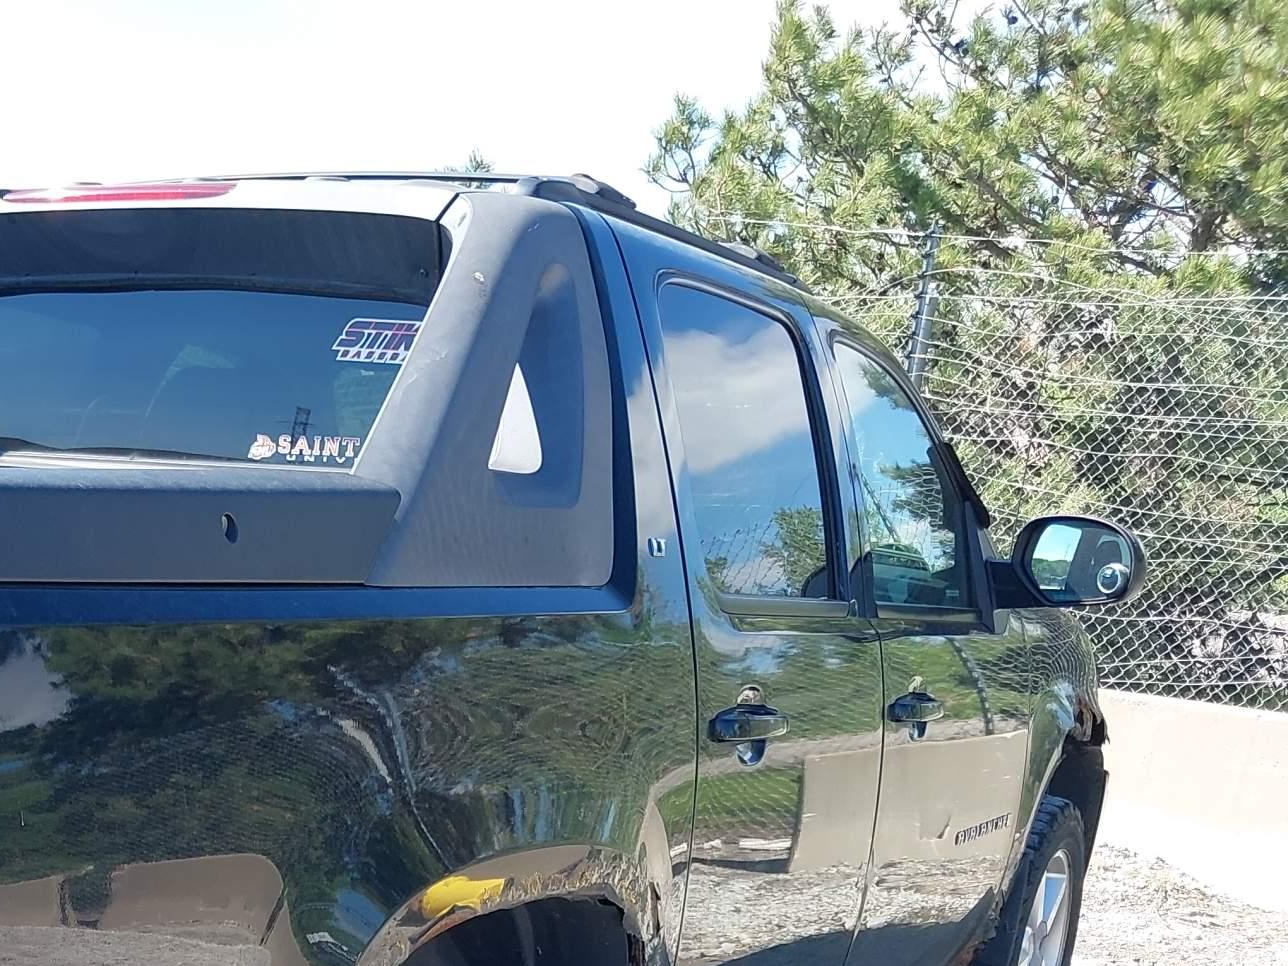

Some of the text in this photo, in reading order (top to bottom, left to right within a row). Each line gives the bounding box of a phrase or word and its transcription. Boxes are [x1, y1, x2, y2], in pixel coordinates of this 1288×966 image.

[338, 349, 408, 361] BASEB
[277, 434, 361, 458] SAINT
[286, 454, 358, 464] UNIV
